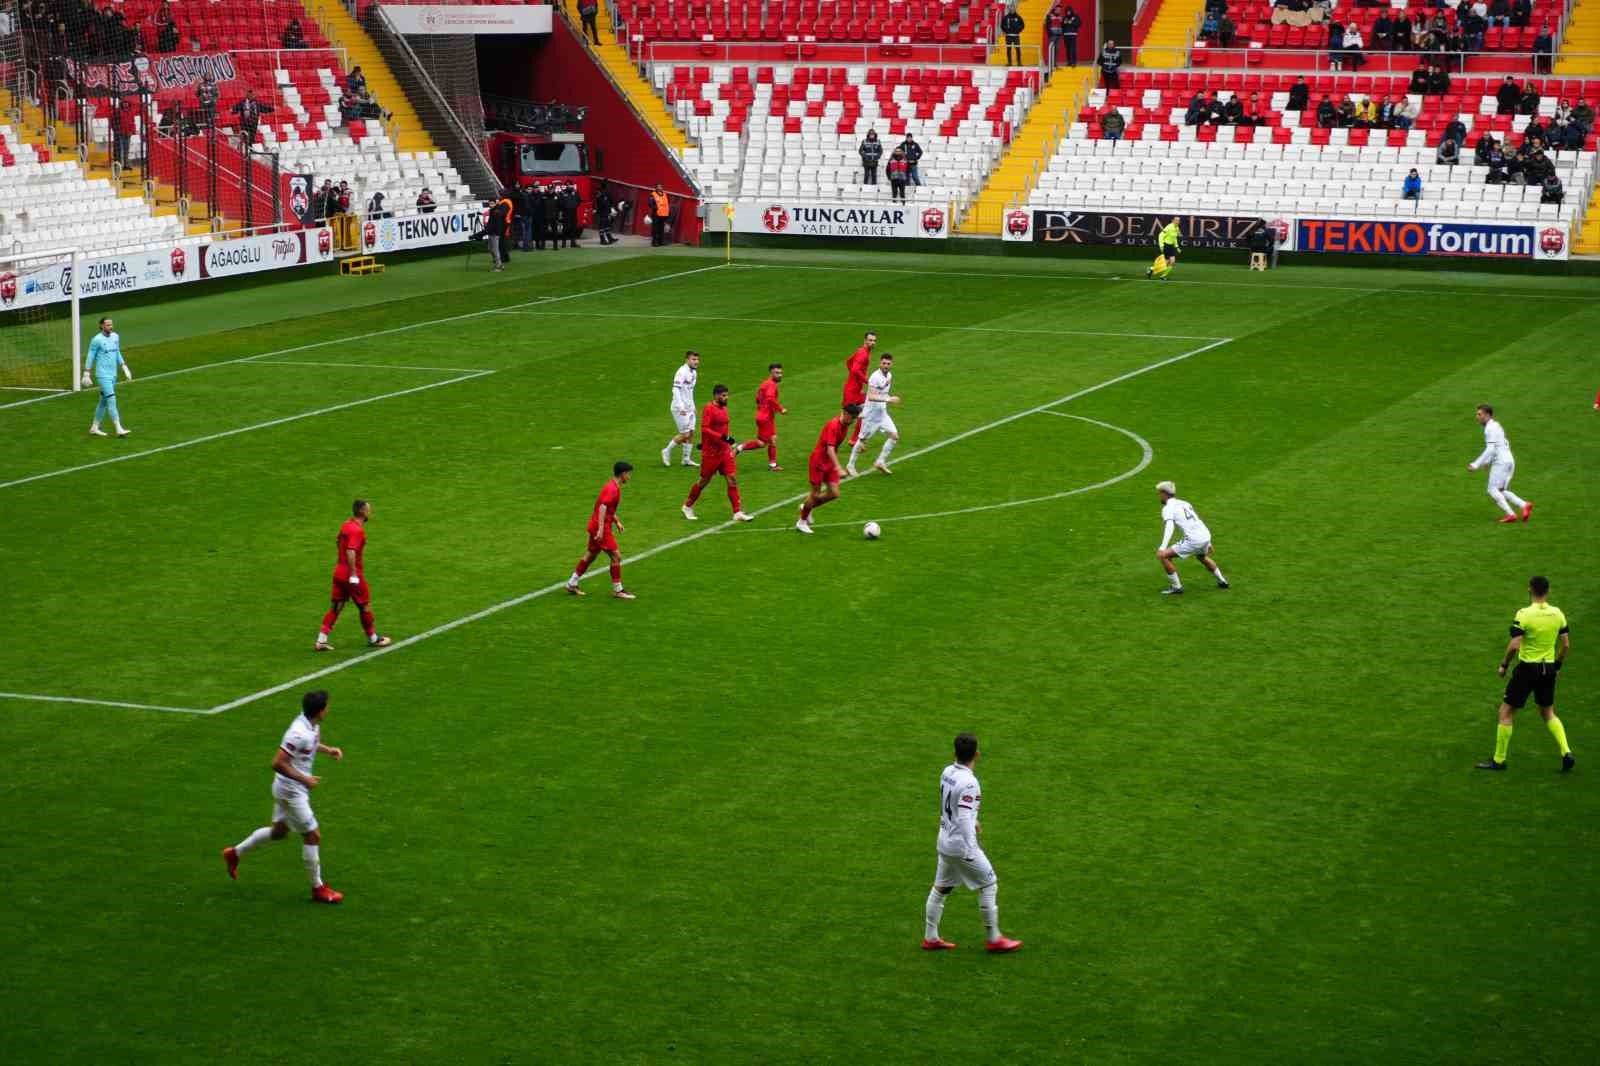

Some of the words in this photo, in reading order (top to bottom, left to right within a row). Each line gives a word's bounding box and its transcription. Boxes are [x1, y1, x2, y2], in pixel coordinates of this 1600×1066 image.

[792, 207, 904, 224] TUNCAYLAR
[398, 217, 439, 240] TEKNO
[801, 223, 832, 234] YAPI
[838, 224, 896, 236] MARKET
[210, 246, 261, 268] AĞAOĞLU
[87, 261, 128, 279] ZÜMRA
[102, 276, 137, 292] MARKET
